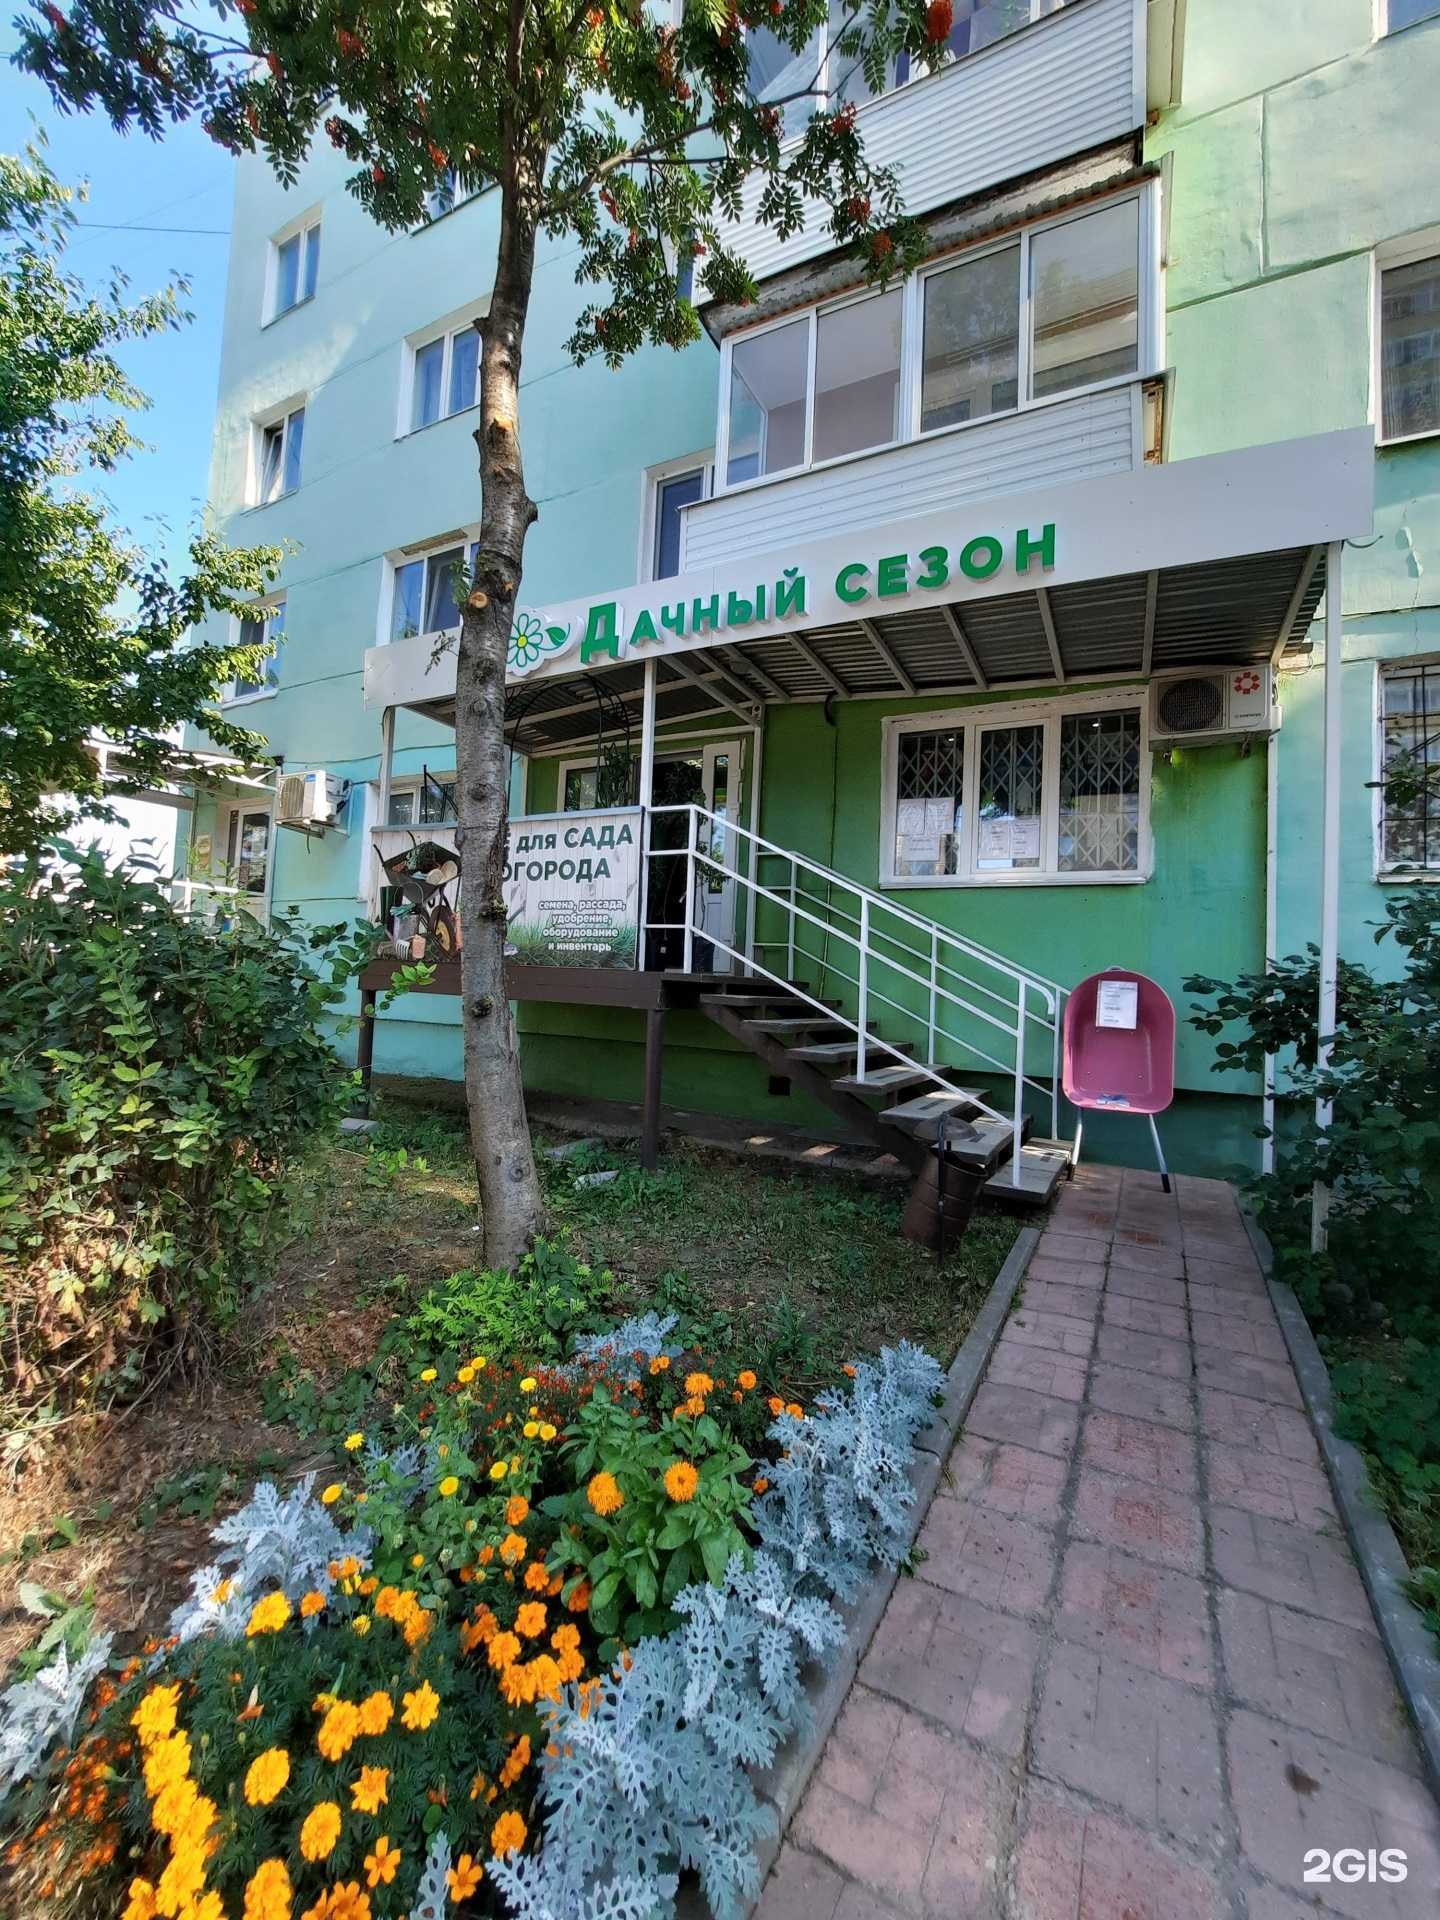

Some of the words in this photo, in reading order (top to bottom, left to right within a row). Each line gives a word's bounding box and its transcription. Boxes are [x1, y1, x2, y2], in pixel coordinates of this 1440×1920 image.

[835, 523, 1056, 603] СЕЗОН
[563, 824, 633, 850] САДА
[539, 901, 577, 911] семена,
[580, 900, 626, 911] рассада,
[552, 913, 612, 926] удобрение,
[543, 928, 619, 938] оборудование
[557, 942, 612, 952] инвентарь
